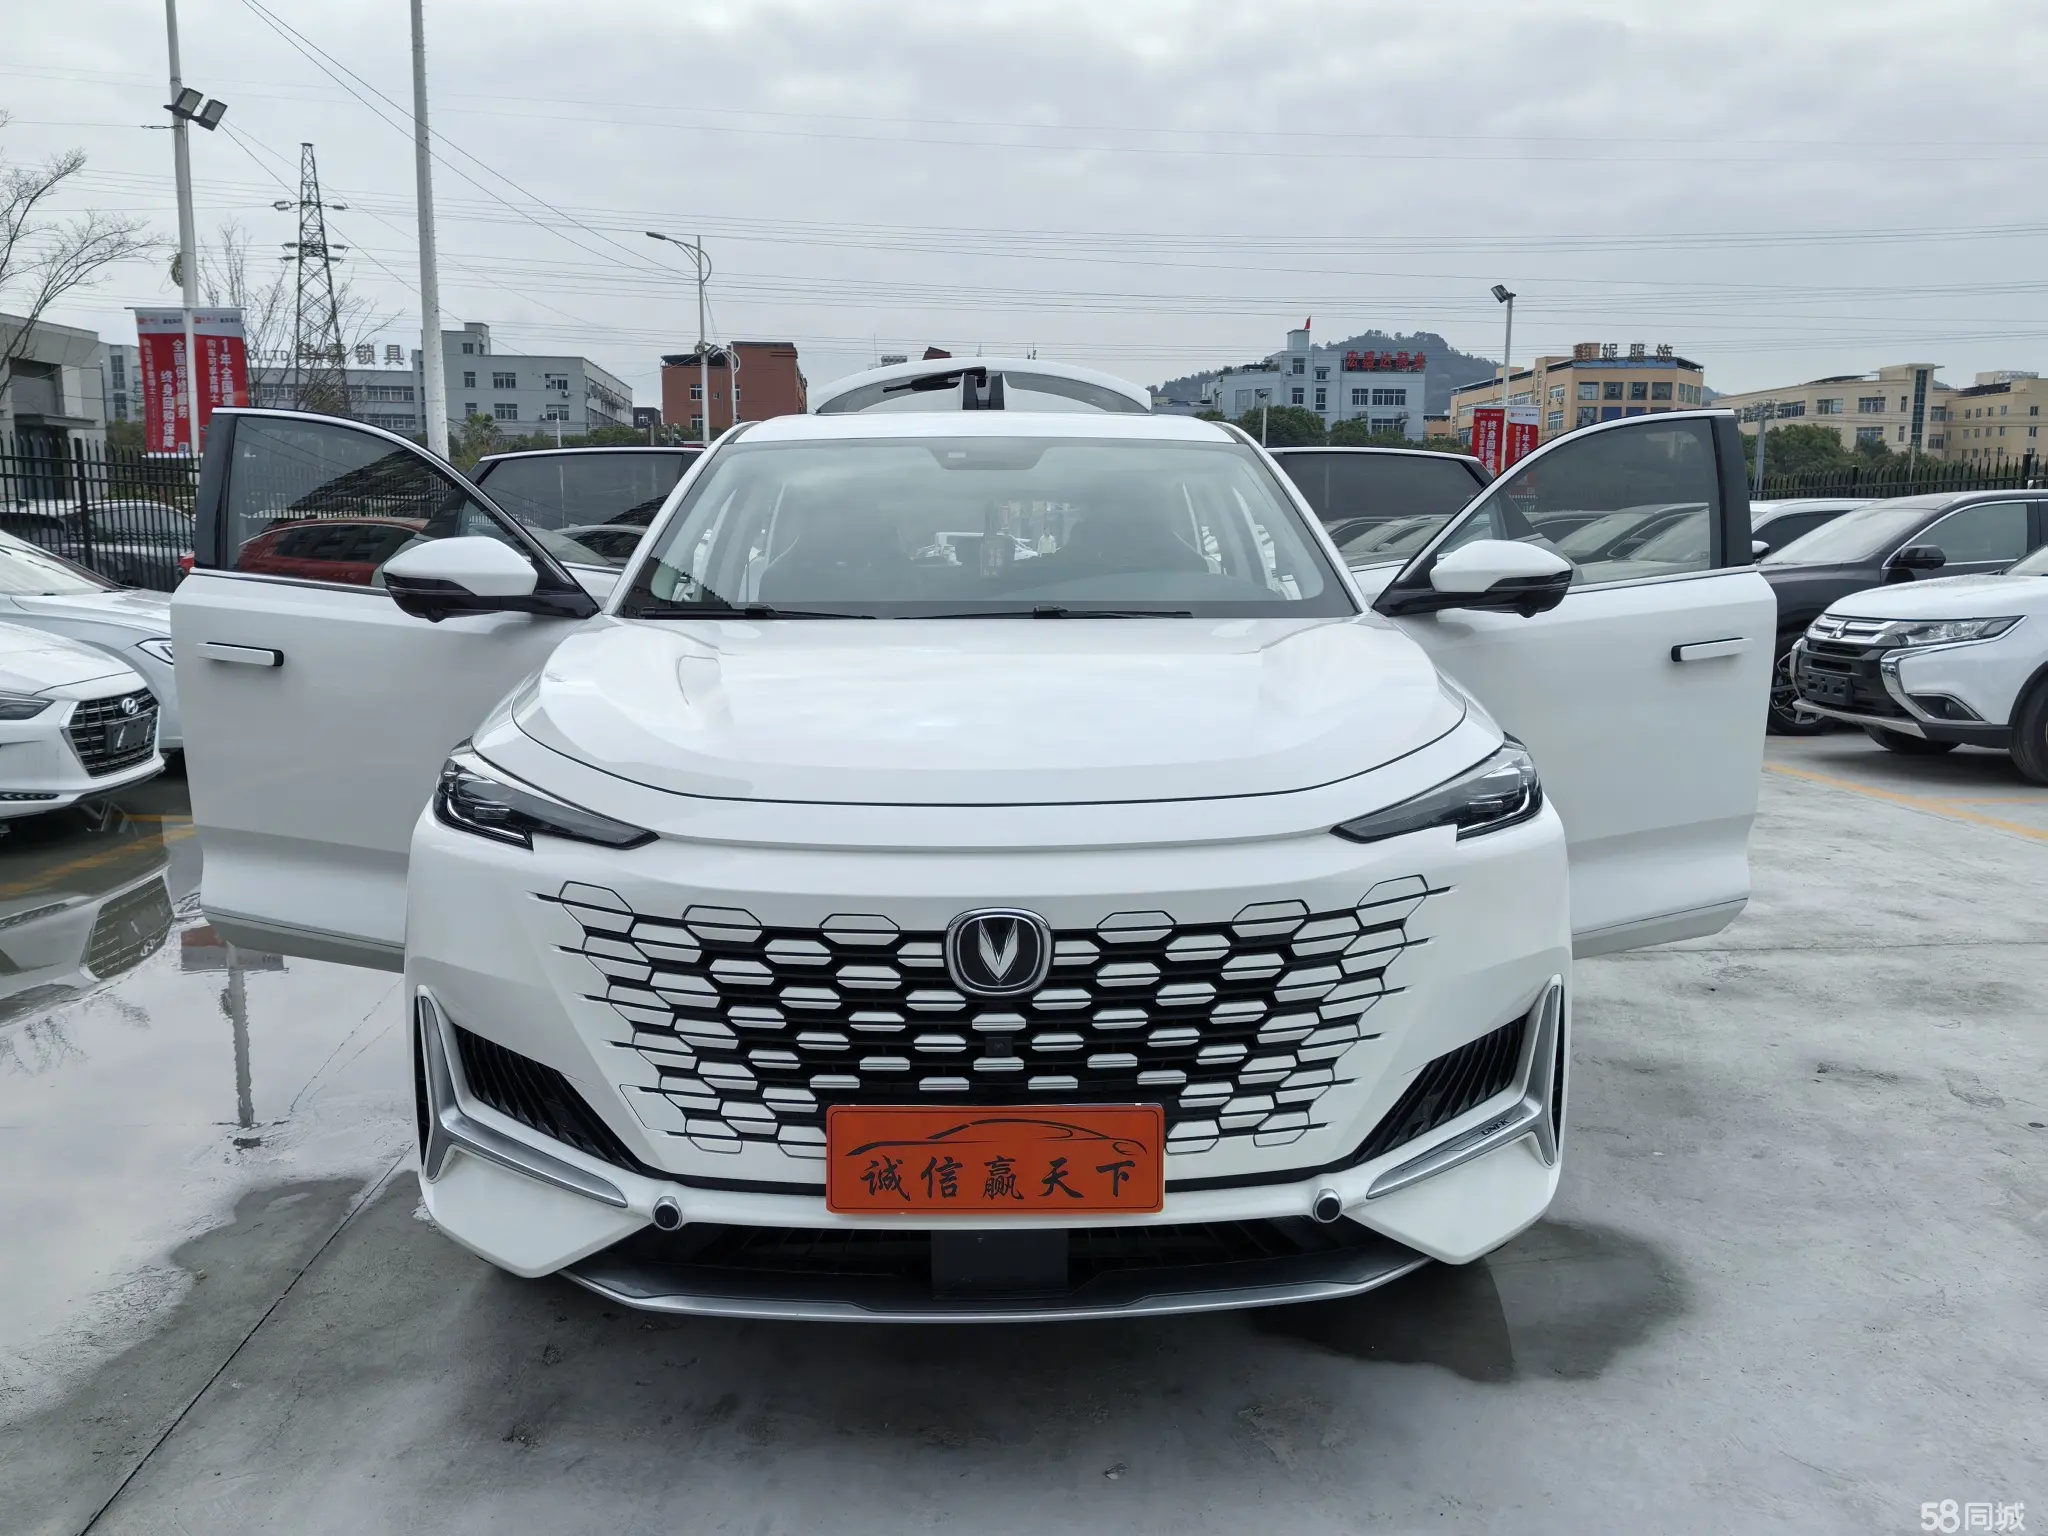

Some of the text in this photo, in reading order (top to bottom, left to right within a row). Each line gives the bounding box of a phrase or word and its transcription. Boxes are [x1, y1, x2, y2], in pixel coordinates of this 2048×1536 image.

[1574, 342, 1673, 363] 韵妮服饰
[160, 370, 176, 448] 终身回购保障
[859, 1155, 1136, 1202] 诚信赢天下
